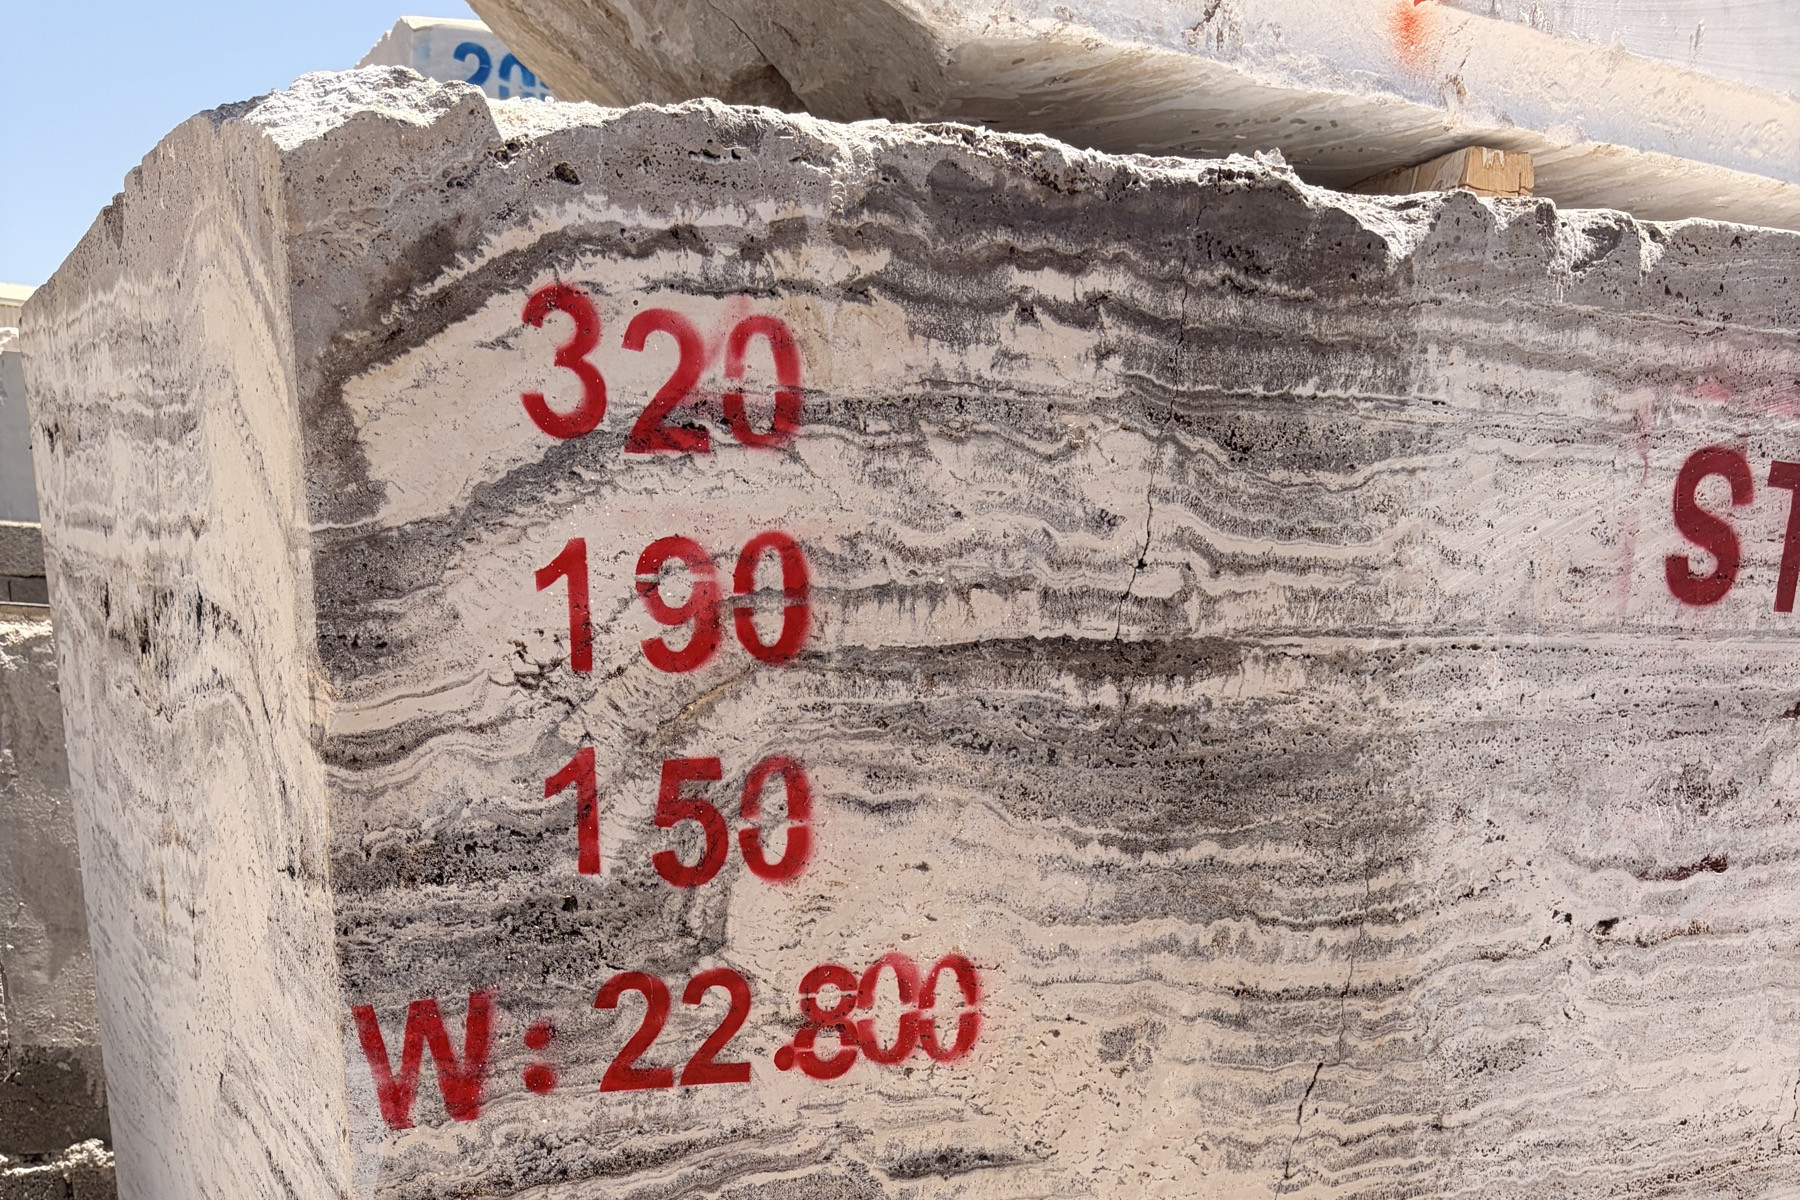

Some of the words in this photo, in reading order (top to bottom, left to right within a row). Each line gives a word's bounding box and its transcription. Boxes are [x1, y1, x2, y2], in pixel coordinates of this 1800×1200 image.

[521, 284, 802, 454] 320
[535, 531, 812, 673] 190
[544, 747, 814, 888] 150
[352, 989, 556, 1130] W:
[594, 953, 981, 1093] 22.800
